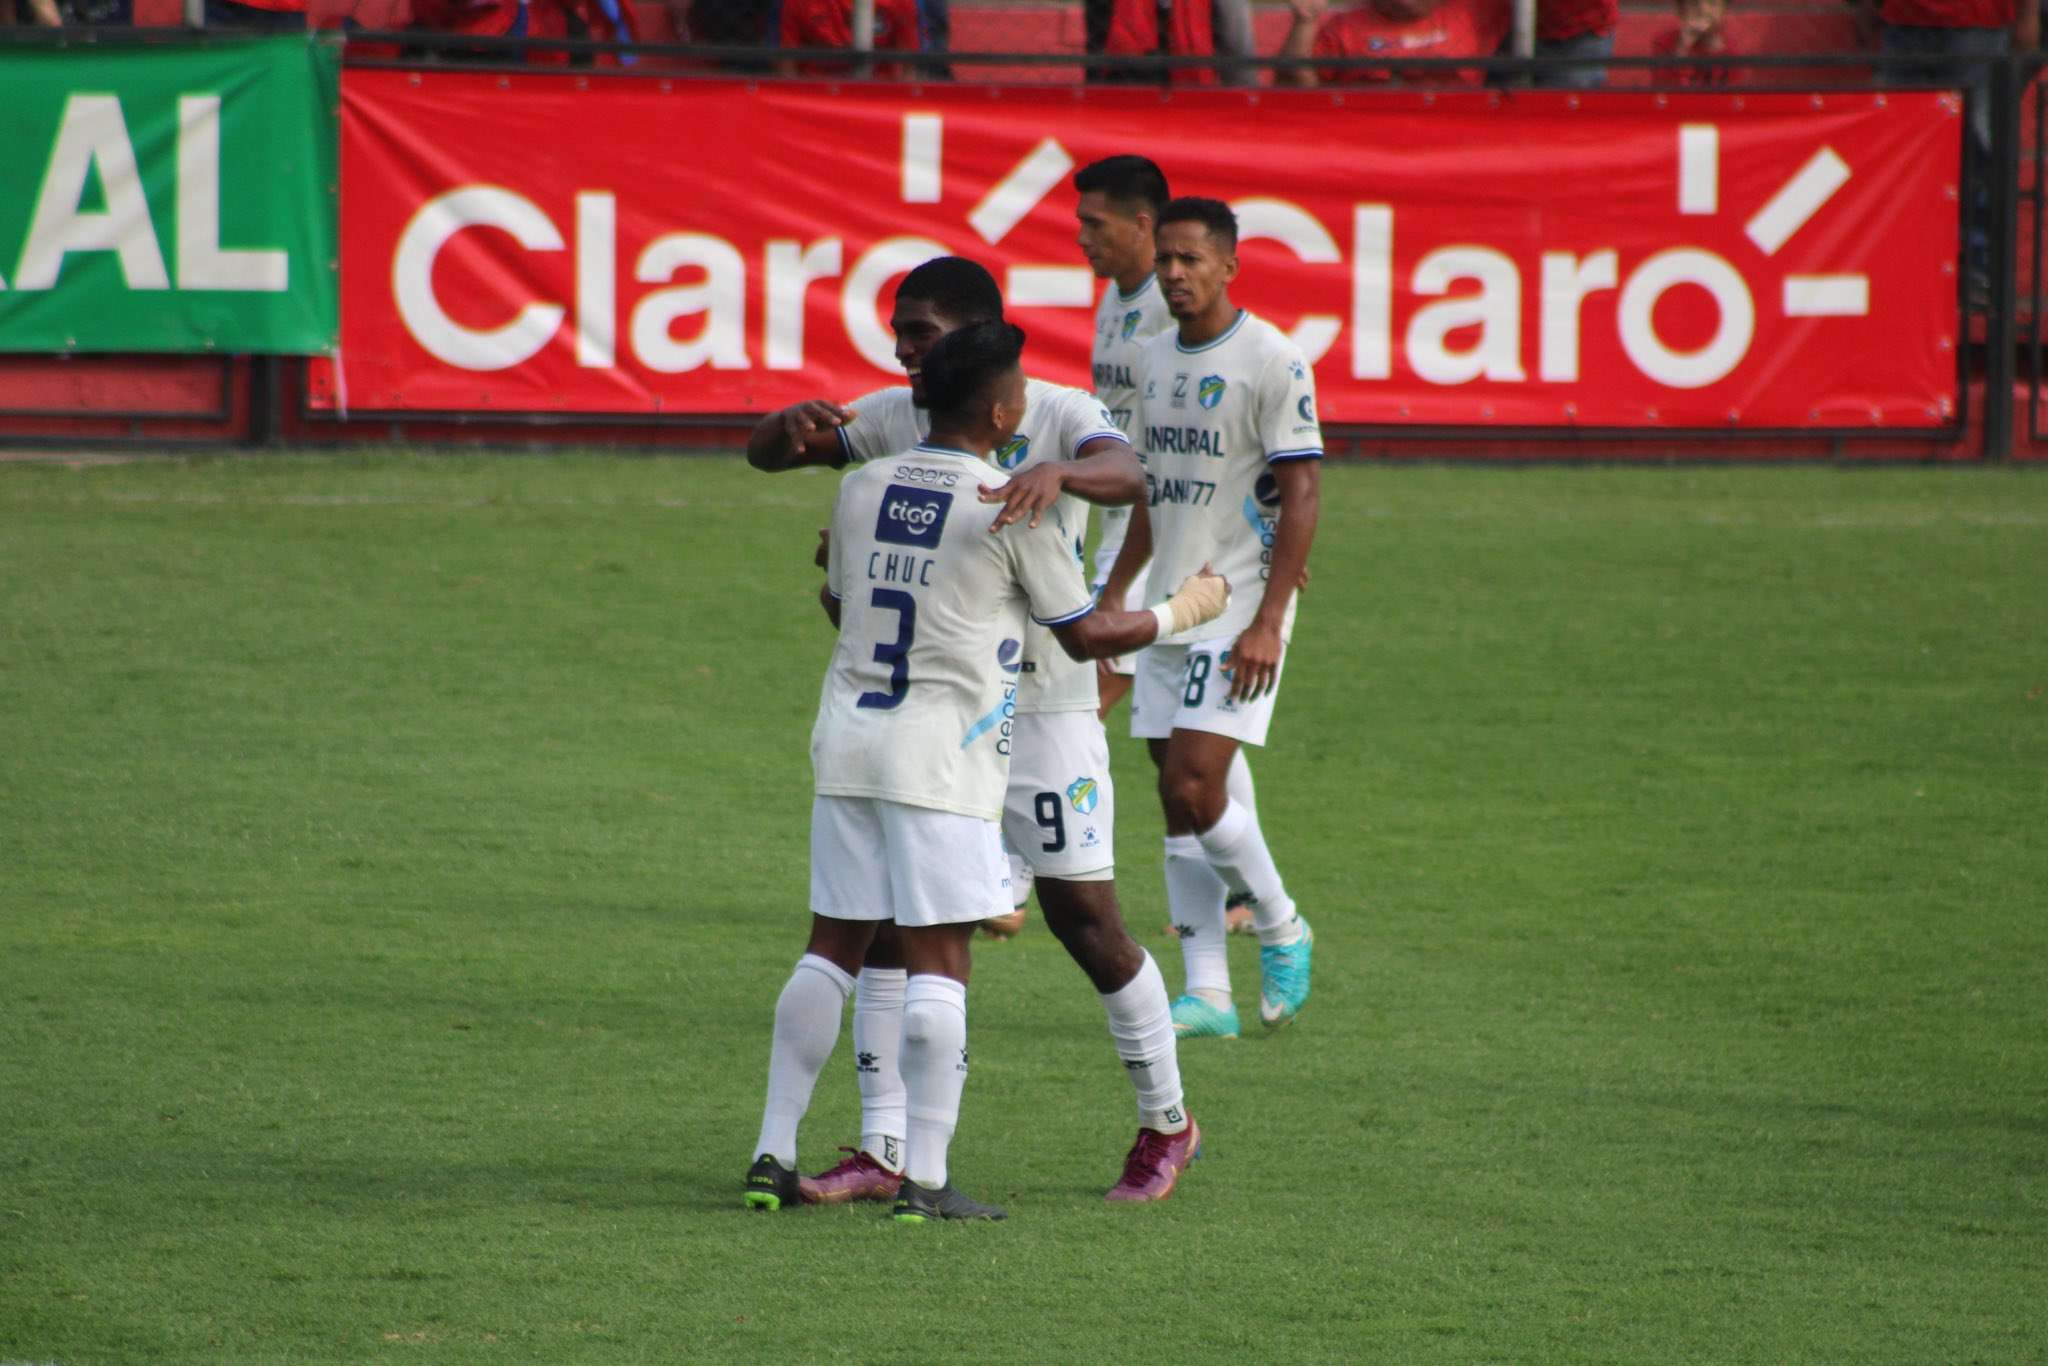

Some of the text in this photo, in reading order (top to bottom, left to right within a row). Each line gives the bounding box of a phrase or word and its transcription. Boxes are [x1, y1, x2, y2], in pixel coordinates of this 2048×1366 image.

[0, 94, 288, 291] AL
[888, 501, 940, 535] tigo
[868, 552, 935, 587] CHUC
[856, 588, 916, 708] 3
[1035, 792, 1066, 853] 9
